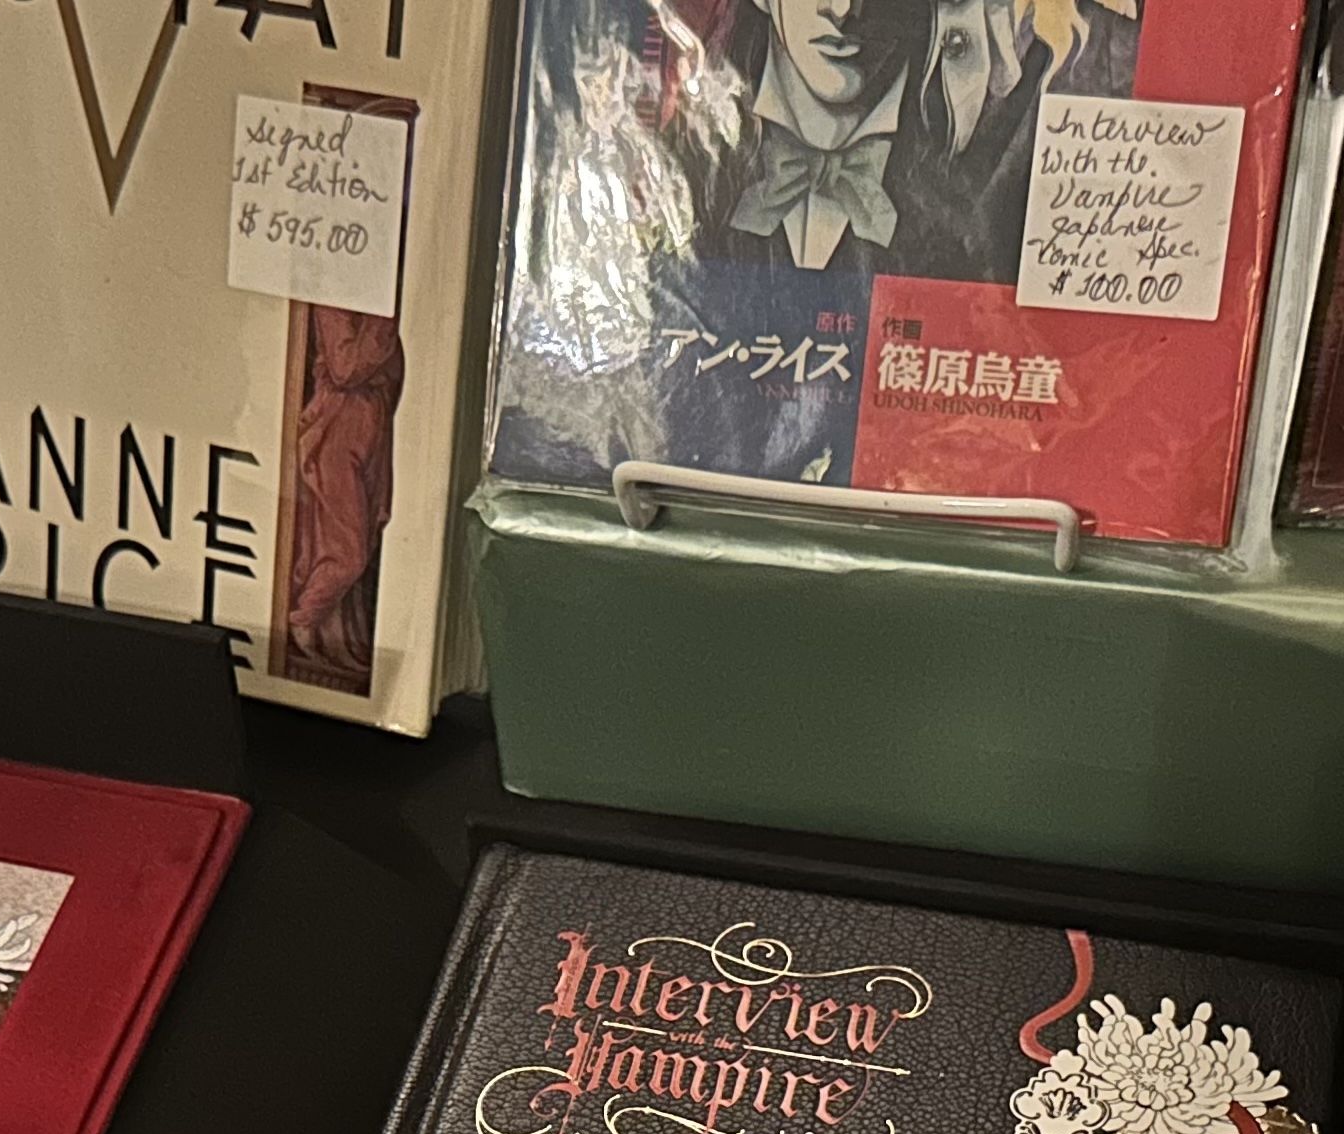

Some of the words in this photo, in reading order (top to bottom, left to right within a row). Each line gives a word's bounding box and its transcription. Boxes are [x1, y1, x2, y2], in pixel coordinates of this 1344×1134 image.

[1046, 108, 1226, 147] Interview
[1049, 178, 1204, 218] Vampire
[873, 393, 929, 414] UDOH
[931, 399, 1045, 423] SHINOHARA
[538, 924, 911, 1056] Interview
